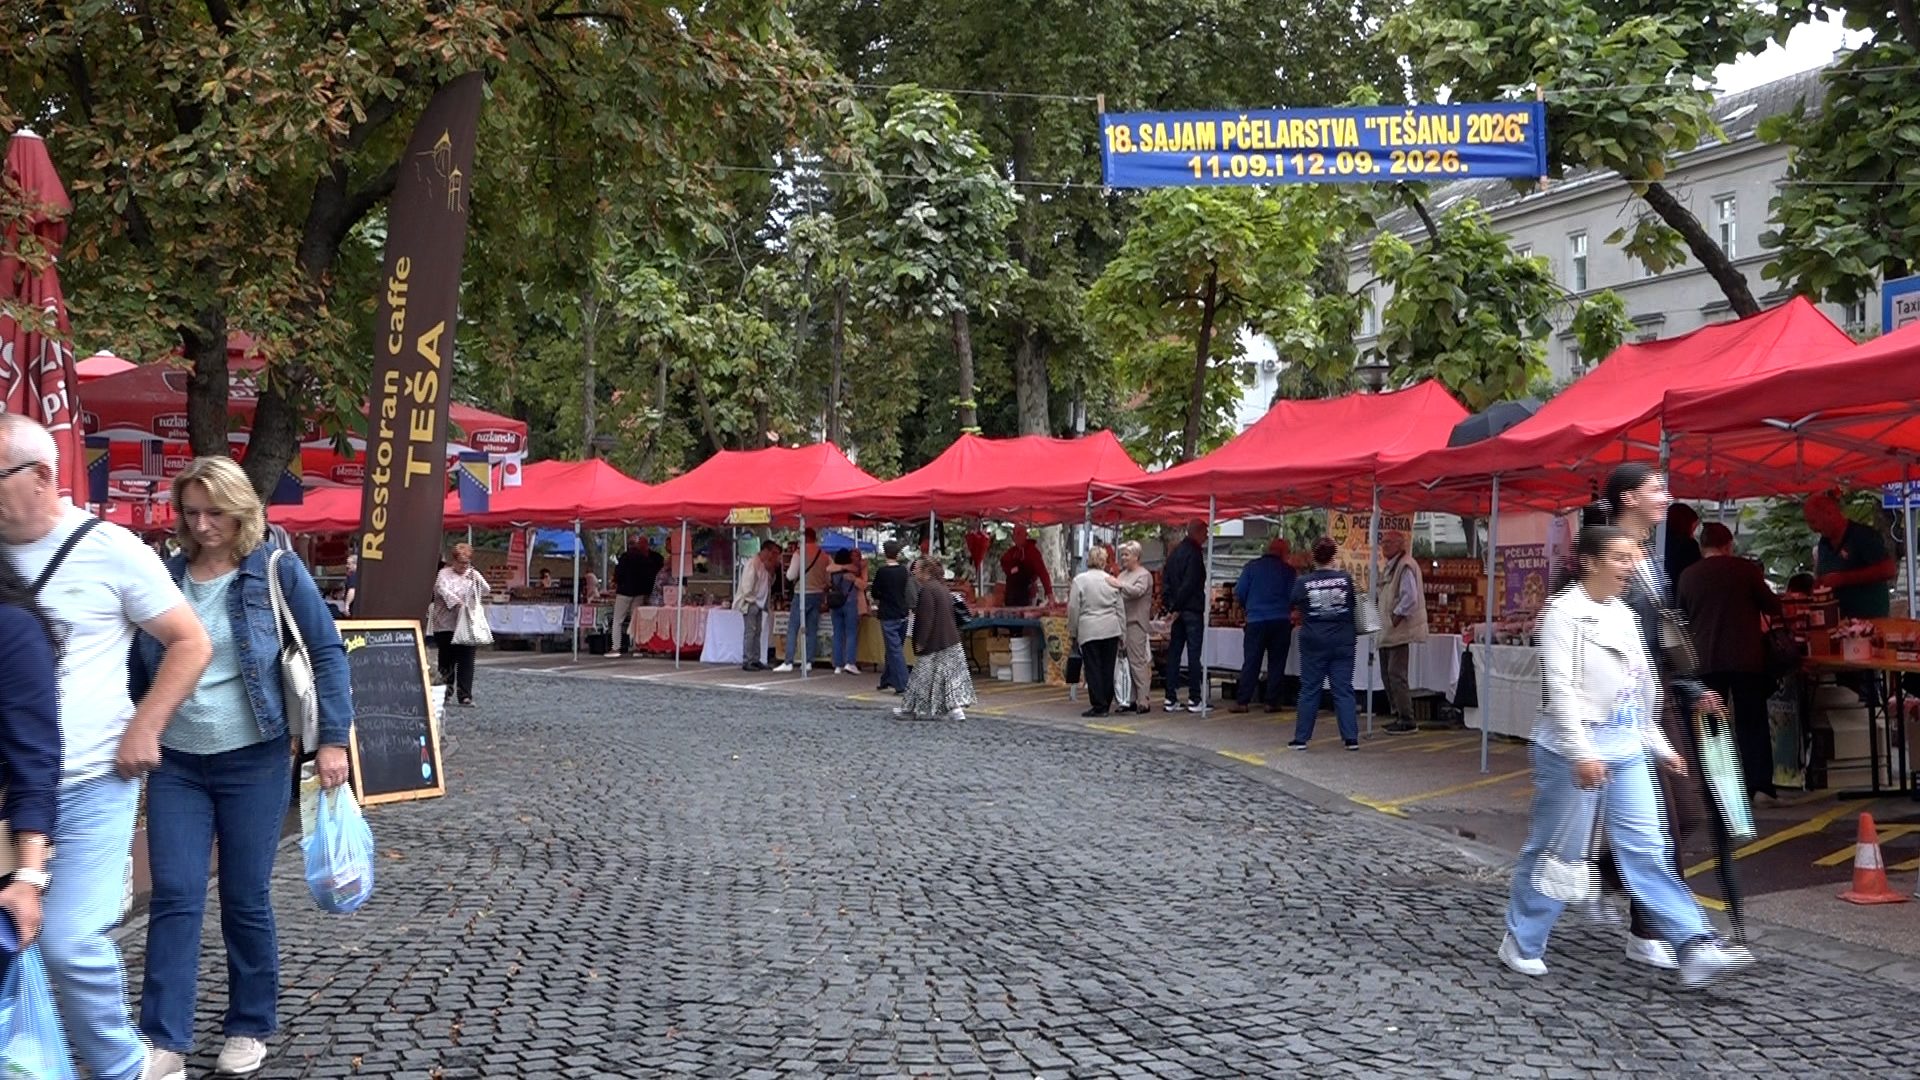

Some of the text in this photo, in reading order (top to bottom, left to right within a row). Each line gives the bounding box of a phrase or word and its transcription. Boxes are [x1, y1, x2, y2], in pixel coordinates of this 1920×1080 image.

[1105, 125, 1137, 153] 18.
[1139, 121, 1216, 153] SAJAM
[1222, 114, 1359, 150] PČELARSTVA
[1364, 109, 1461, 147] "TEŠANJ
[1389, 149, 1469, 174] 2026.
[361, 256, 411, 560] Restoran caffe
[404, 321, 445, 488] TEŠA
